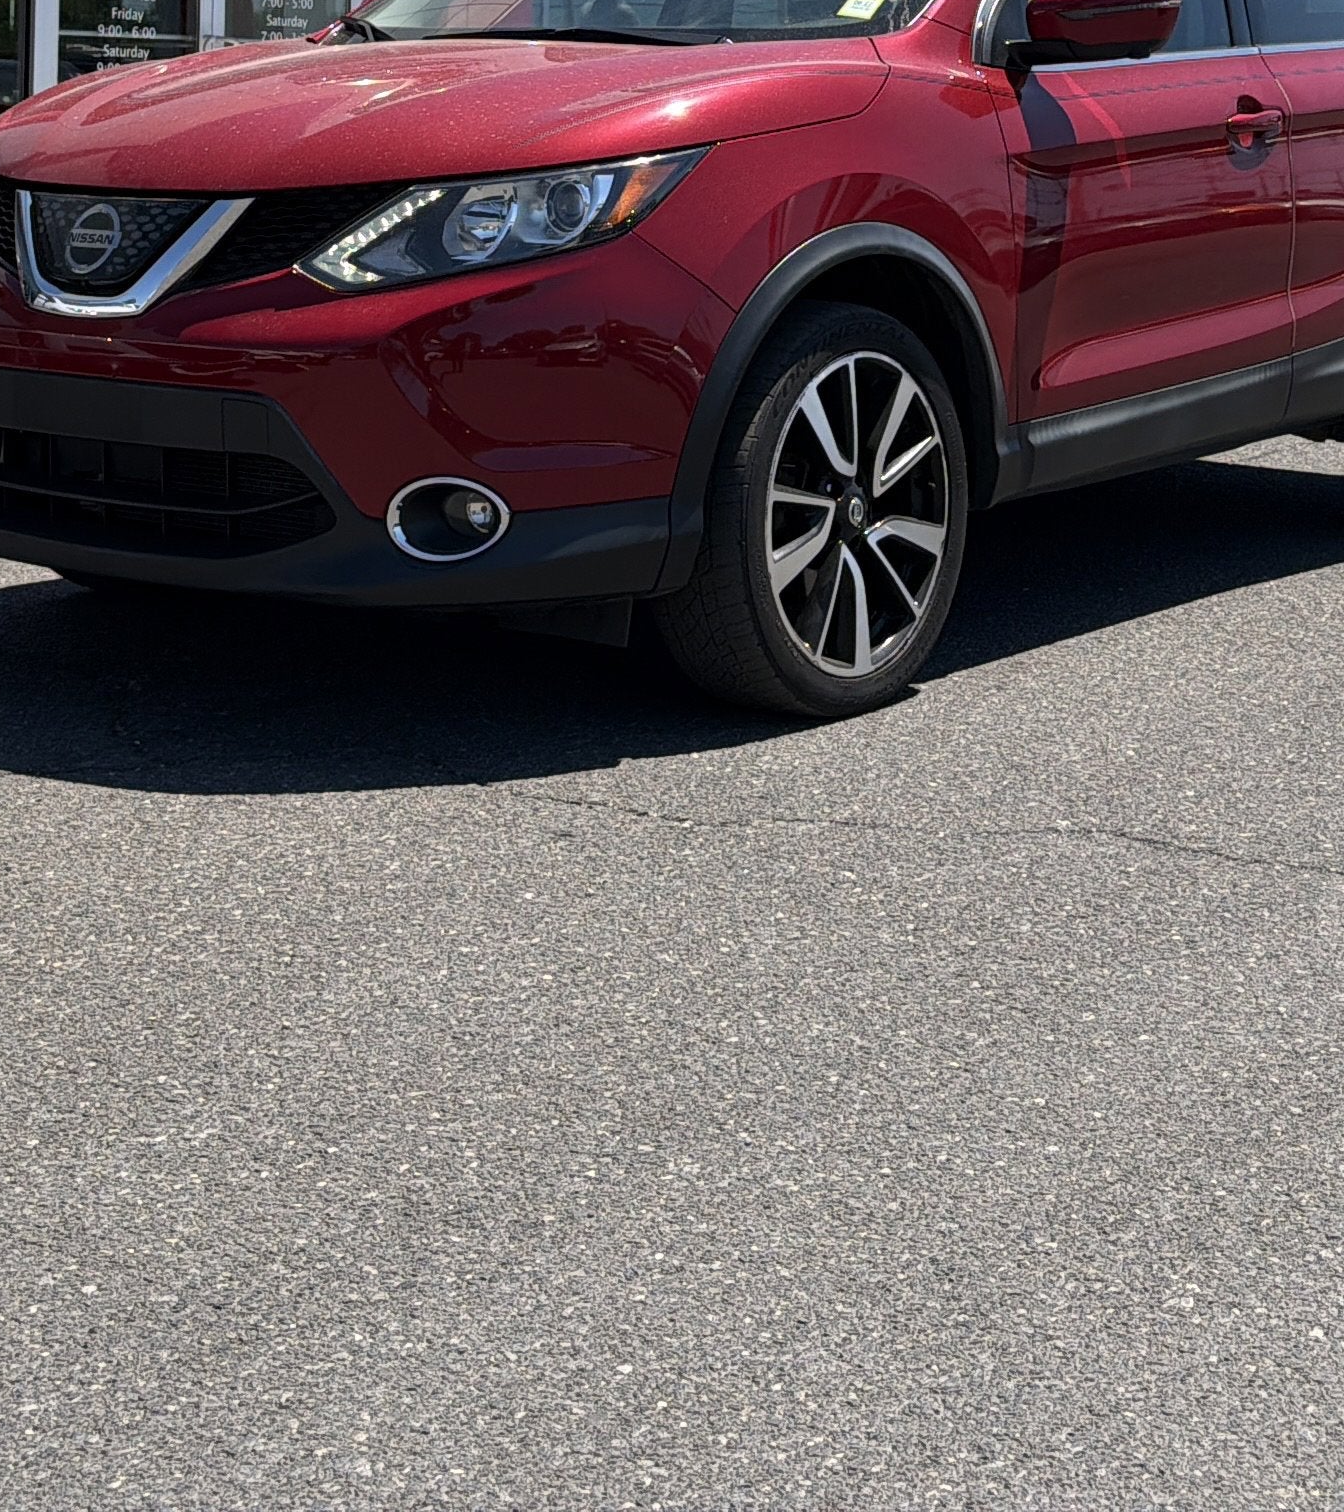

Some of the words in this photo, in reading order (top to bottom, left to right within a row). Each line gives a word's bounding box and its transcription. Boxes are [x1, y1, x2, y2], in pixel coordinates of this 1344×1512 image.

[111, 6, 144, 23] Friday
[266, 14, 308, 30] Saturday
[97, 24, 123, 37] 9:00
[131, 26, 156, 39] 6:00
[102, 44, 150, 60] Saturday
[69, 232, 114, 245] NISSAN
